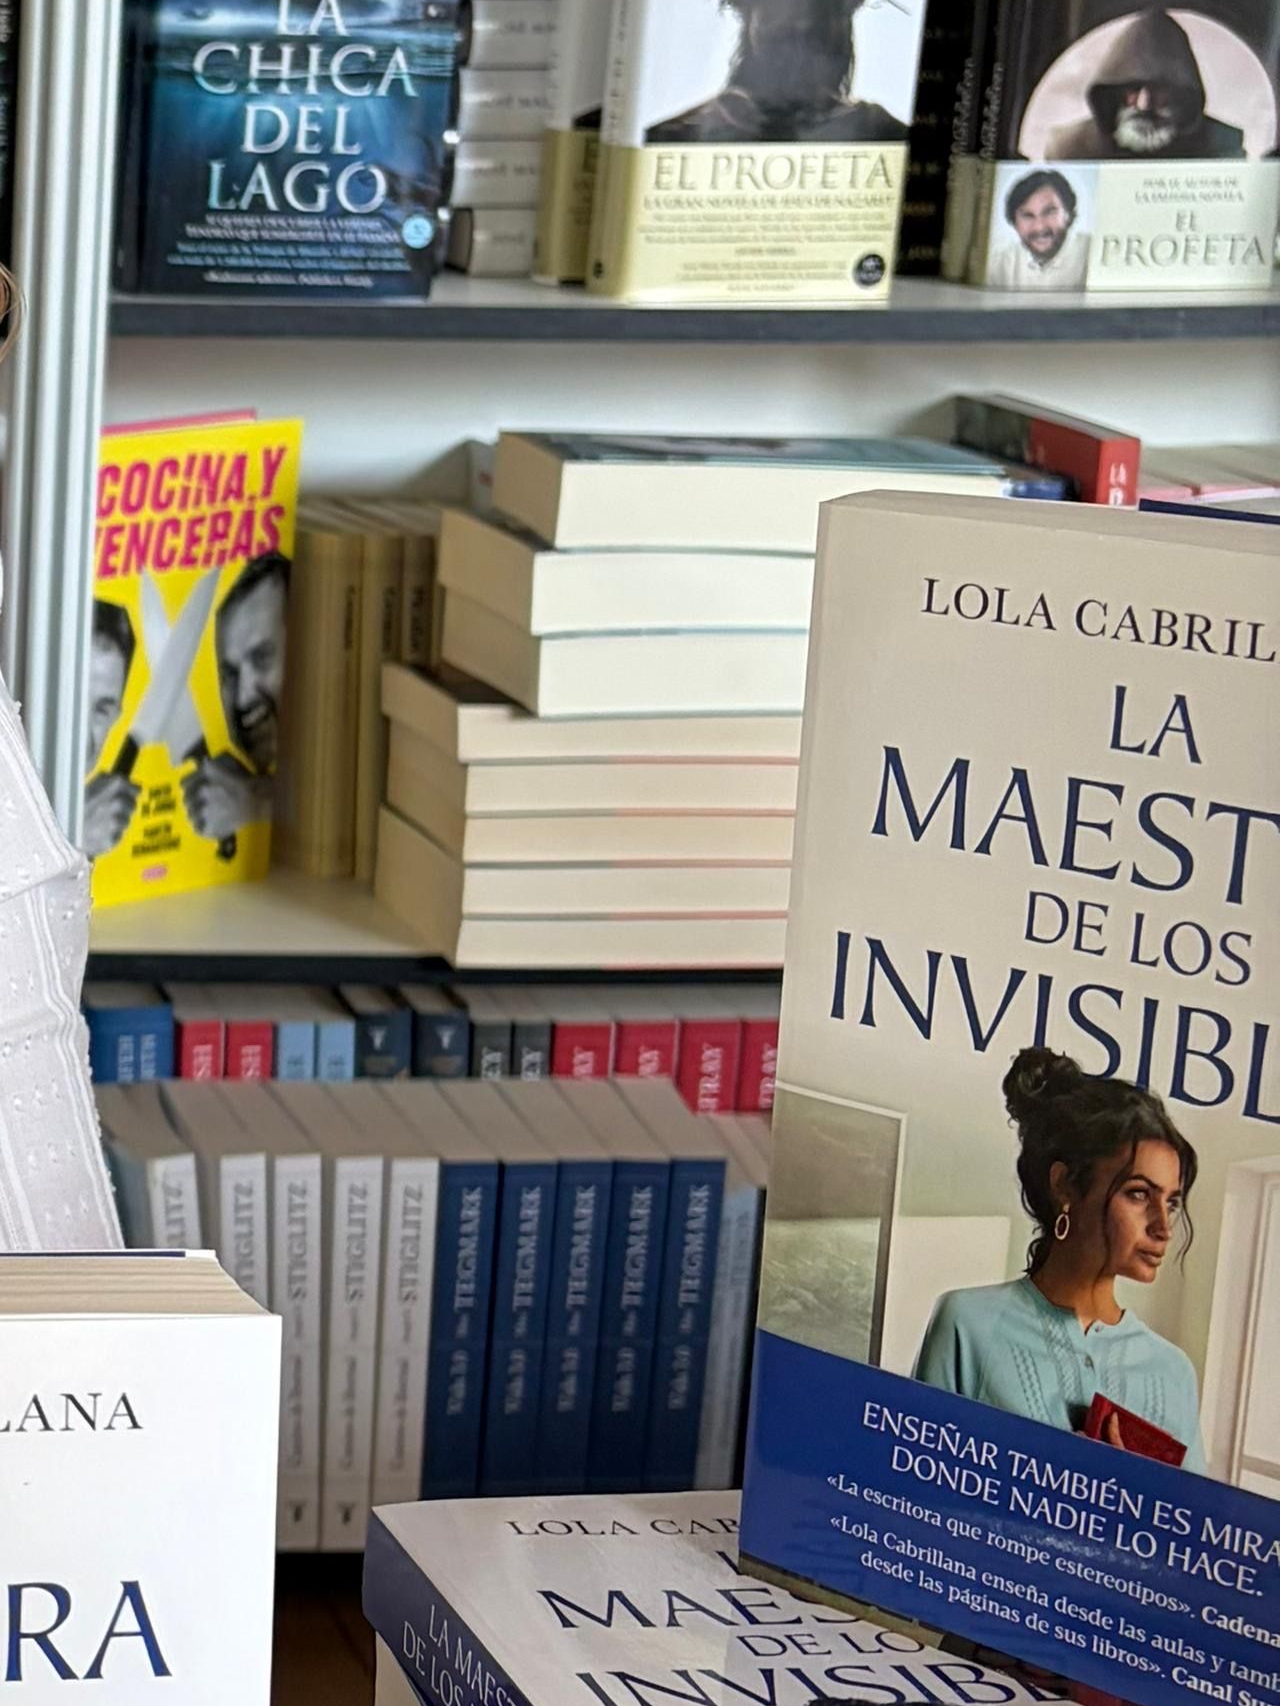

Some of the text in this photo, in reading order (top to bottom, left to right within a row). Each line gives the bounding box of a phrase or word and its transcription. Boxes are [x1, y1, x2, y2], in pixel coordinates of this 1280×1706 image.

[96, 446, 287, 519] COCINA Y
[95, 496, 286, 579] ENCERÁS
[921, 577, 1280, 662] LOLA CABRIL
[1110, 685, 1202, 764] LA
[1025, 891, 1252, 986] DE LOS
[863, 1401, 998, 1470] ENSEÑAR
[1007, 1450, 1144, 1519] TAMBIÉN
[1152, 1500, 1192, 1535] ES
[891, 1446, 1263, 1597] DONDE NADIE LO HACE.
[403, 1620, 427, 1677] DE
[429, 1604, 452, 1659] LA
